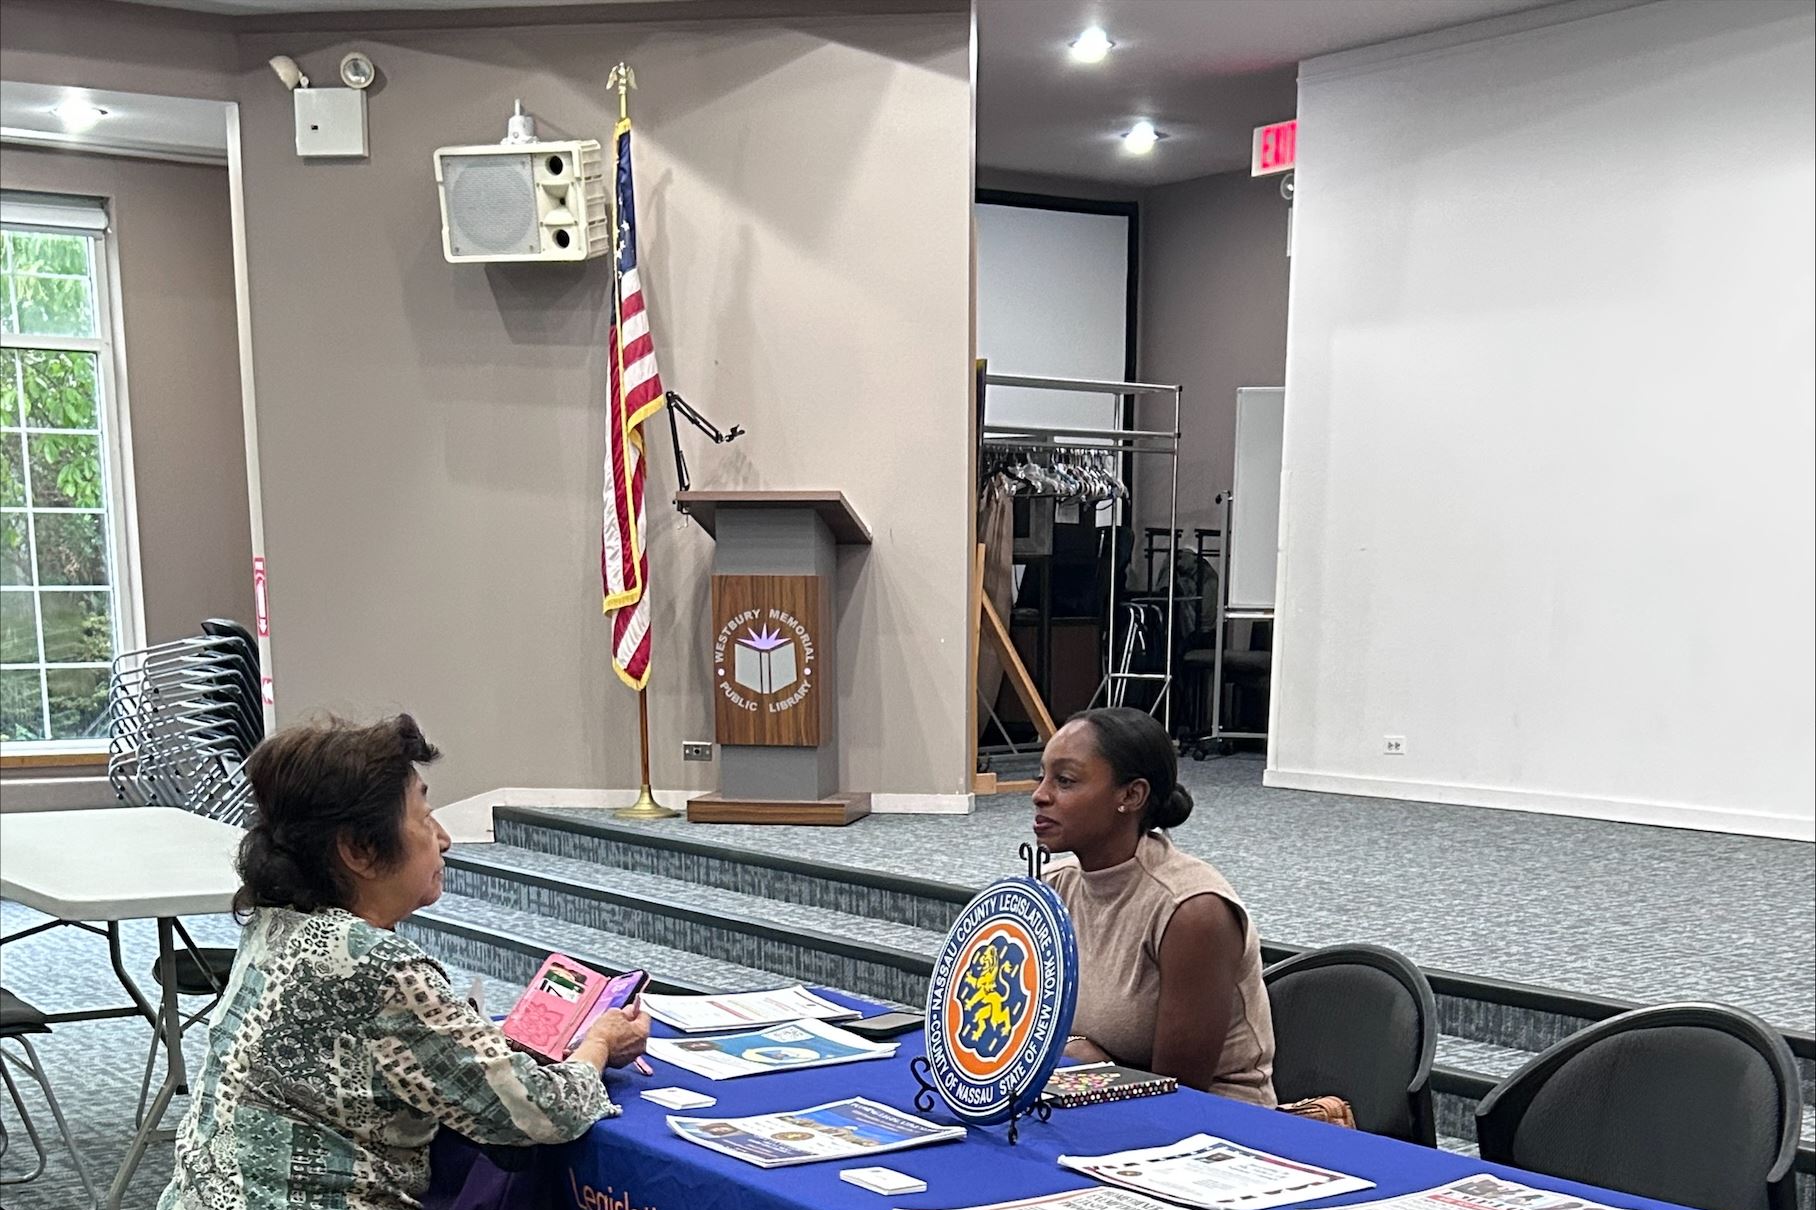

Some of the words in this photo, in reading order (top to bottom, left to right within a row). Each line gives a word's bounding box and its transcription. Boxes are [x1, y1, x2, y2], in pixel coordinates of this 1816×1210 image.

[714, 608, 760, 663] WESTBURY
[769, 608, 814, 663] MEMORIAL
[719, 680, 758, 712] PUBLIC
[769, 679, 812, 713] LIBRARY
[931, 941, 958, 1011] NASSAU
[956, 894, 997, 943] COUNTY
[999, 893, 1052, 952] LEGISLATURE
[930, 1019, 949, 1076] COUNTY
[945, 1074, 956, 1094] OF
[955, 1083, 994, 1105] NASSAU
[999, 1064, 1027, 1097] STATE
[1025, 1042, 1038, 1064] OF
[1033, 1005, 1051, 1040] NEW
[1043, 954, 1056, 1002] YORK
